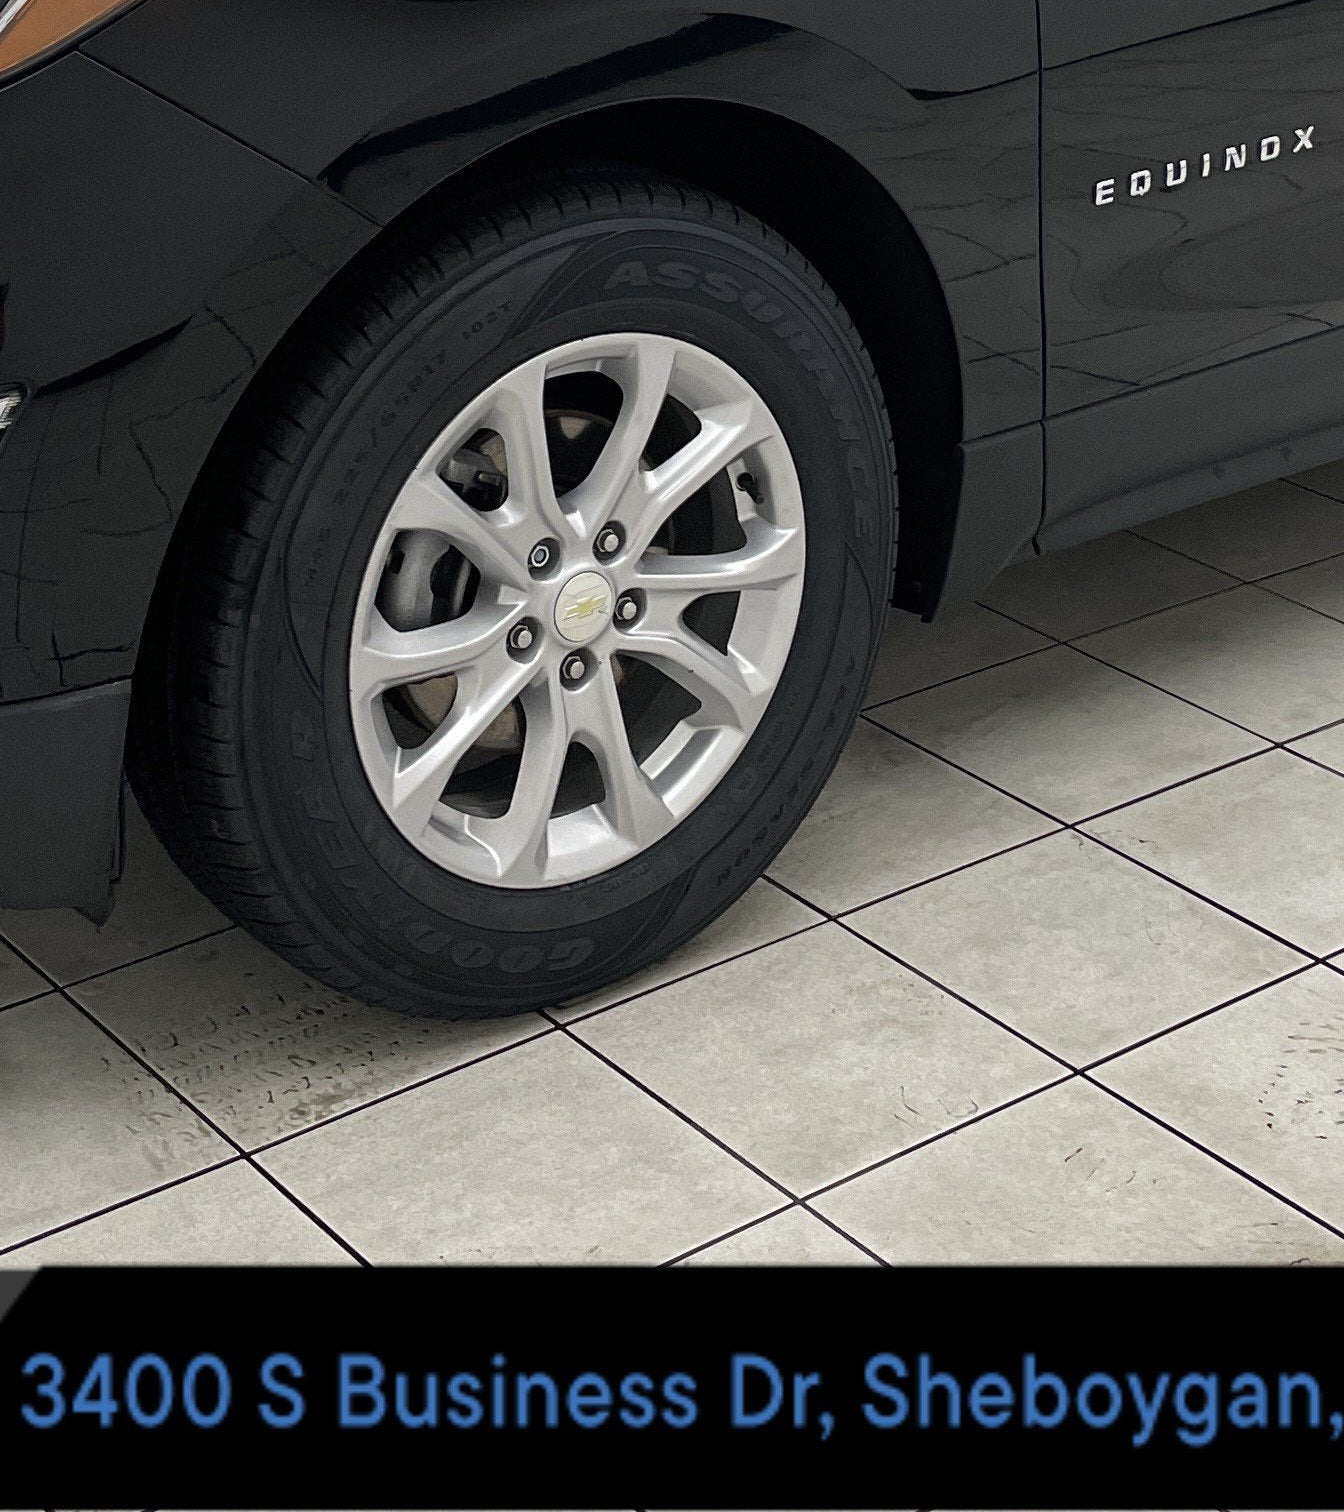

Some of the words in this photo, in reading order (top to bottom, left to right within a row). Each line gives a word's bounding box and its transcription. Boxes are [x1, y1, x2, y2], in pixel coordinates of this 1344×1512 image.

[1094, 125, 1315, 207] EQUINOX
[602, 260, 874, 545] ASSURANCE
[290, 710, 596, 976] GOODYEAR
